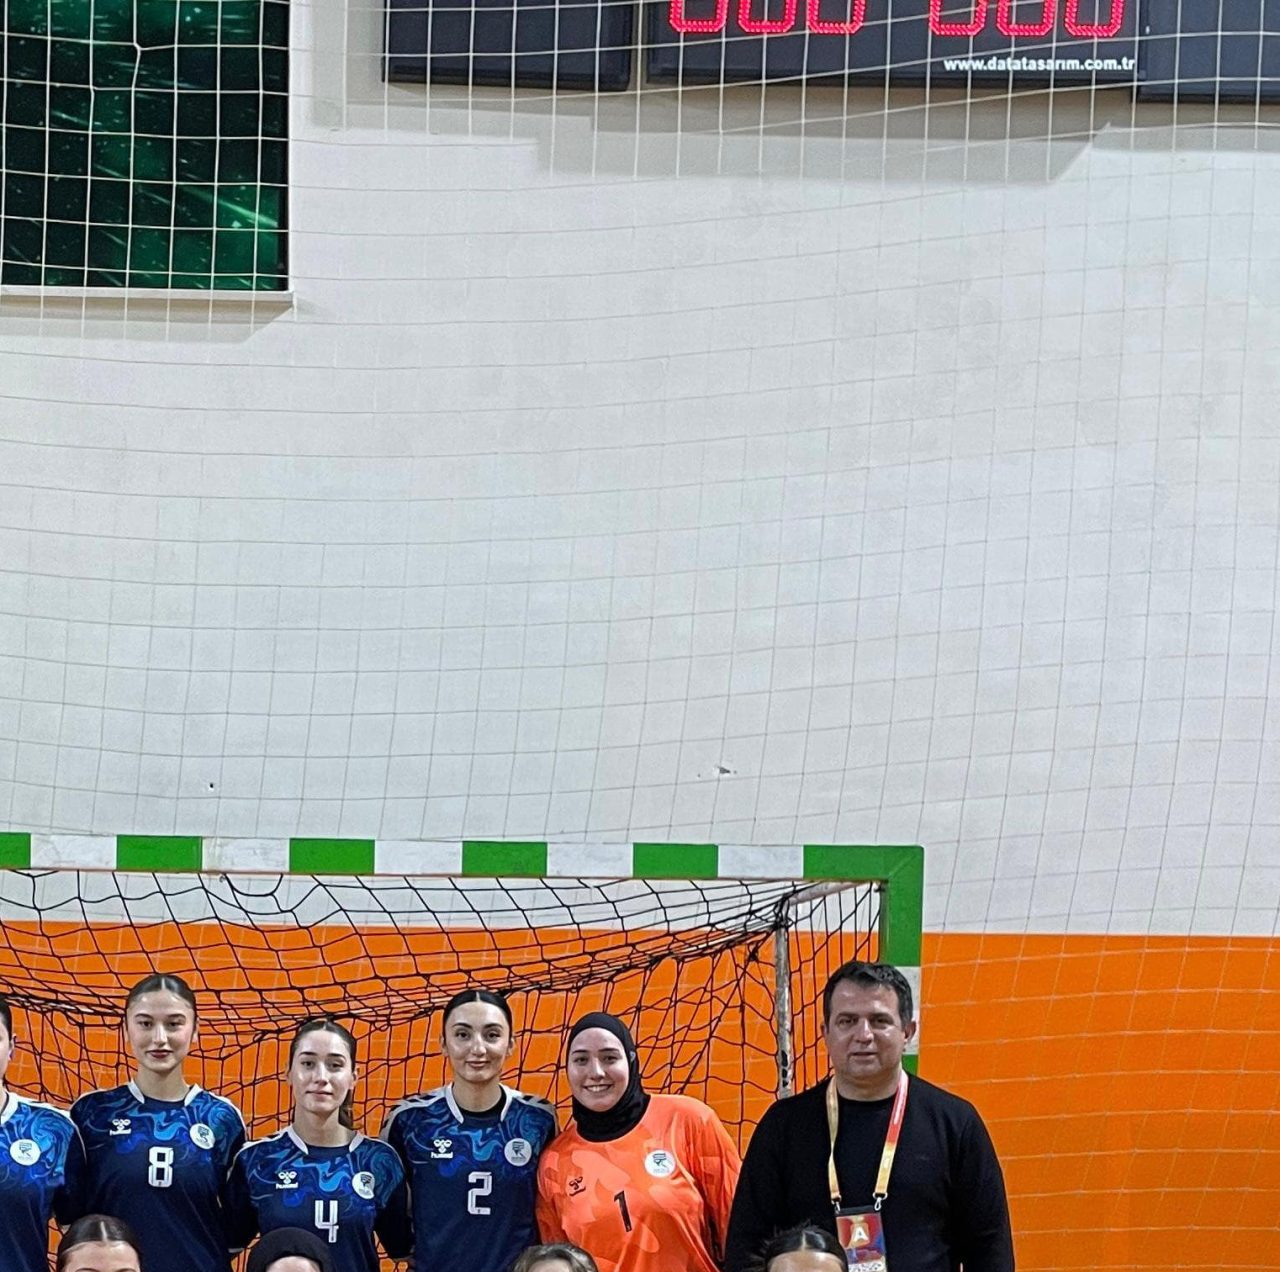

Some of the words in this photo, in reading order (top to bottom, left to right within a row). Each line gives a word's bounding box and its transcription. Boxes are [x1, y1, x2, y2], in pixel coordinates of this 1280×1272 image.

[148, 1146, 174, 1187] 8
[467, 1171, 492, 1215] 2
[613, 1190, 632, 1232] 1
[314, 1199, 339, 1243] 4
